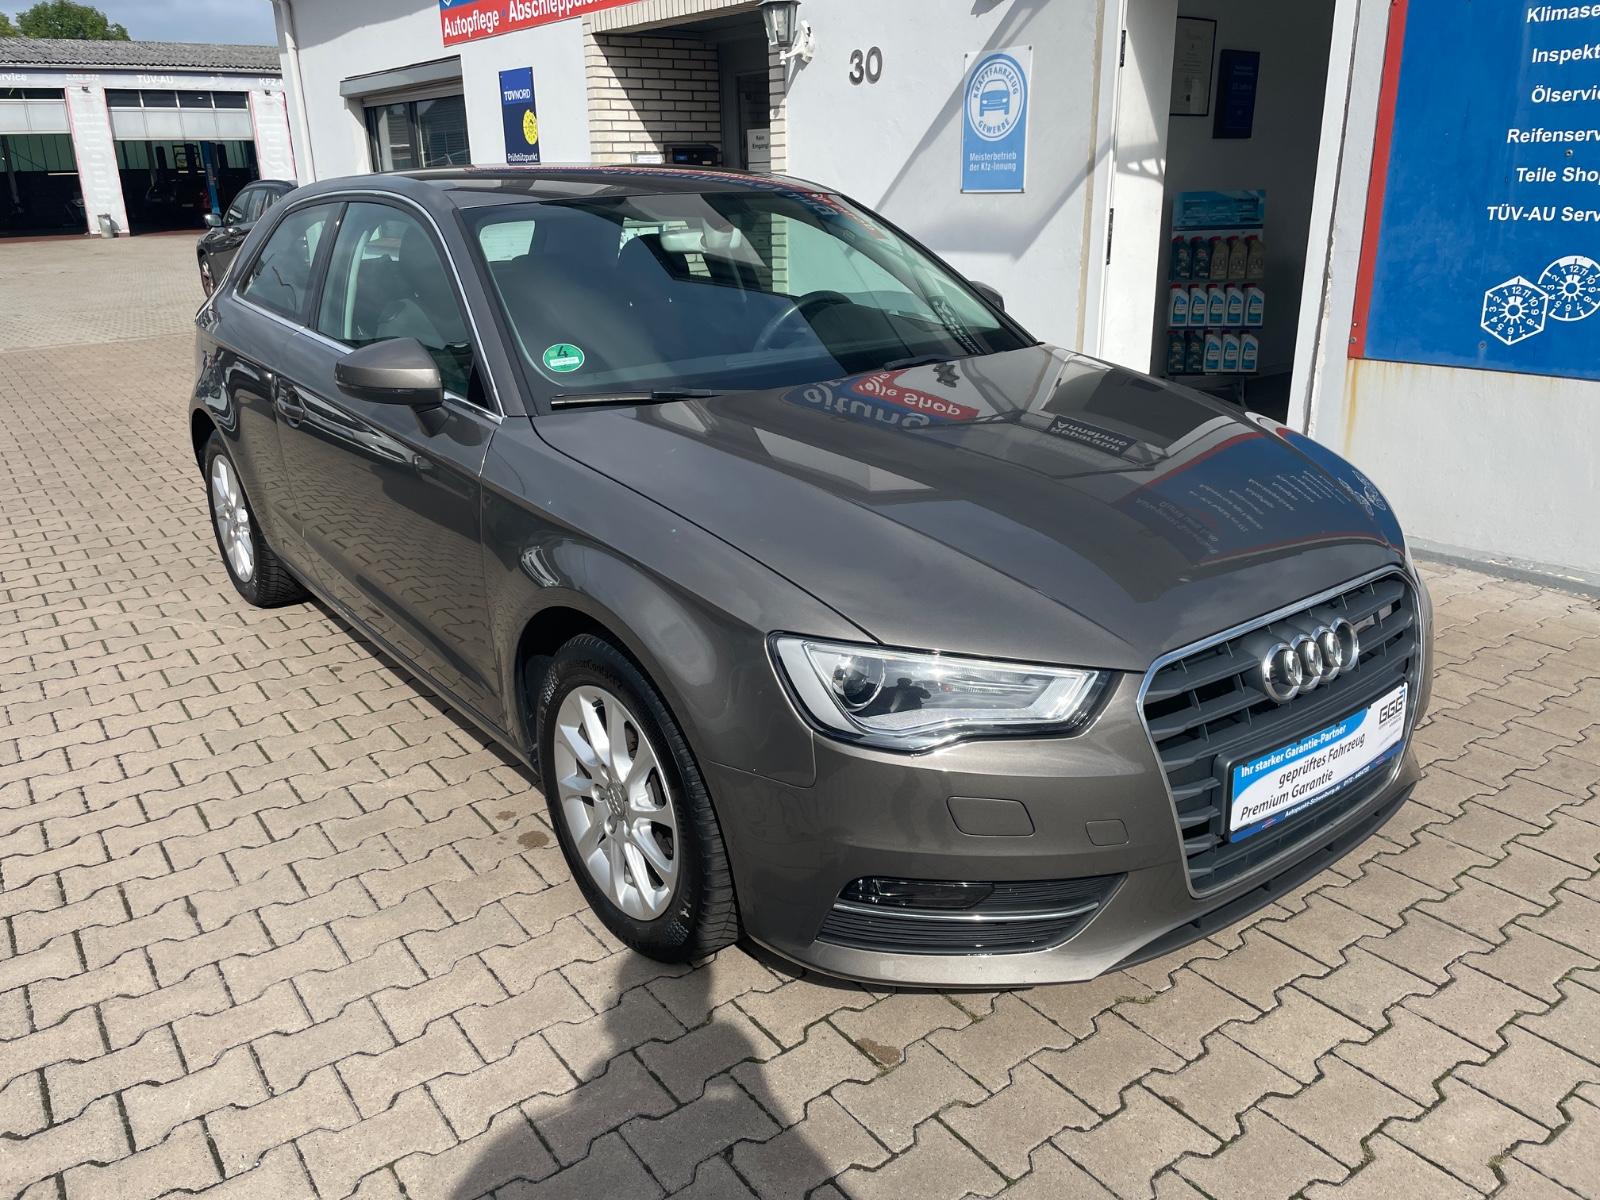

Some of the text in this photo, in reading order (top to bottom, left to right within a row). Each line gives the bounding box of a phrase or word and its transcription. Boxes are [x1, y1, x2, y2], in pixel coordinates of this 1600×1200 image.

[444, 10, 500, 38] Autopflege
[849, 46, 882, 85] 30
[973, 66, 1019, 98] KRAFTFAHRZEUG
[1531, 85, 1600, 103] Ölservi
[978, 119, 1011, 134] GEWERBE
[969, 151, 1017, 161] Meisterbetrieb
[969, 161, 1017, 173] der Kfz-Innung
[1516, 167, 1557, 182] Teile
[1487, 203, 1556, 221] TÜV-AU
[557, 345, 569, 358] 4
[1378, 694, 1405, 725] GGG
[1241, 724, 1347, 778] Ihr starker Garantie-Partner
[1278, 754, 1327, 789] geprüftes
[1327, 732, 1366, 763] Fahrzeug
[1240, 791, 1290, 821] Premium
[1291, 768, 1334, 799] Garantie
